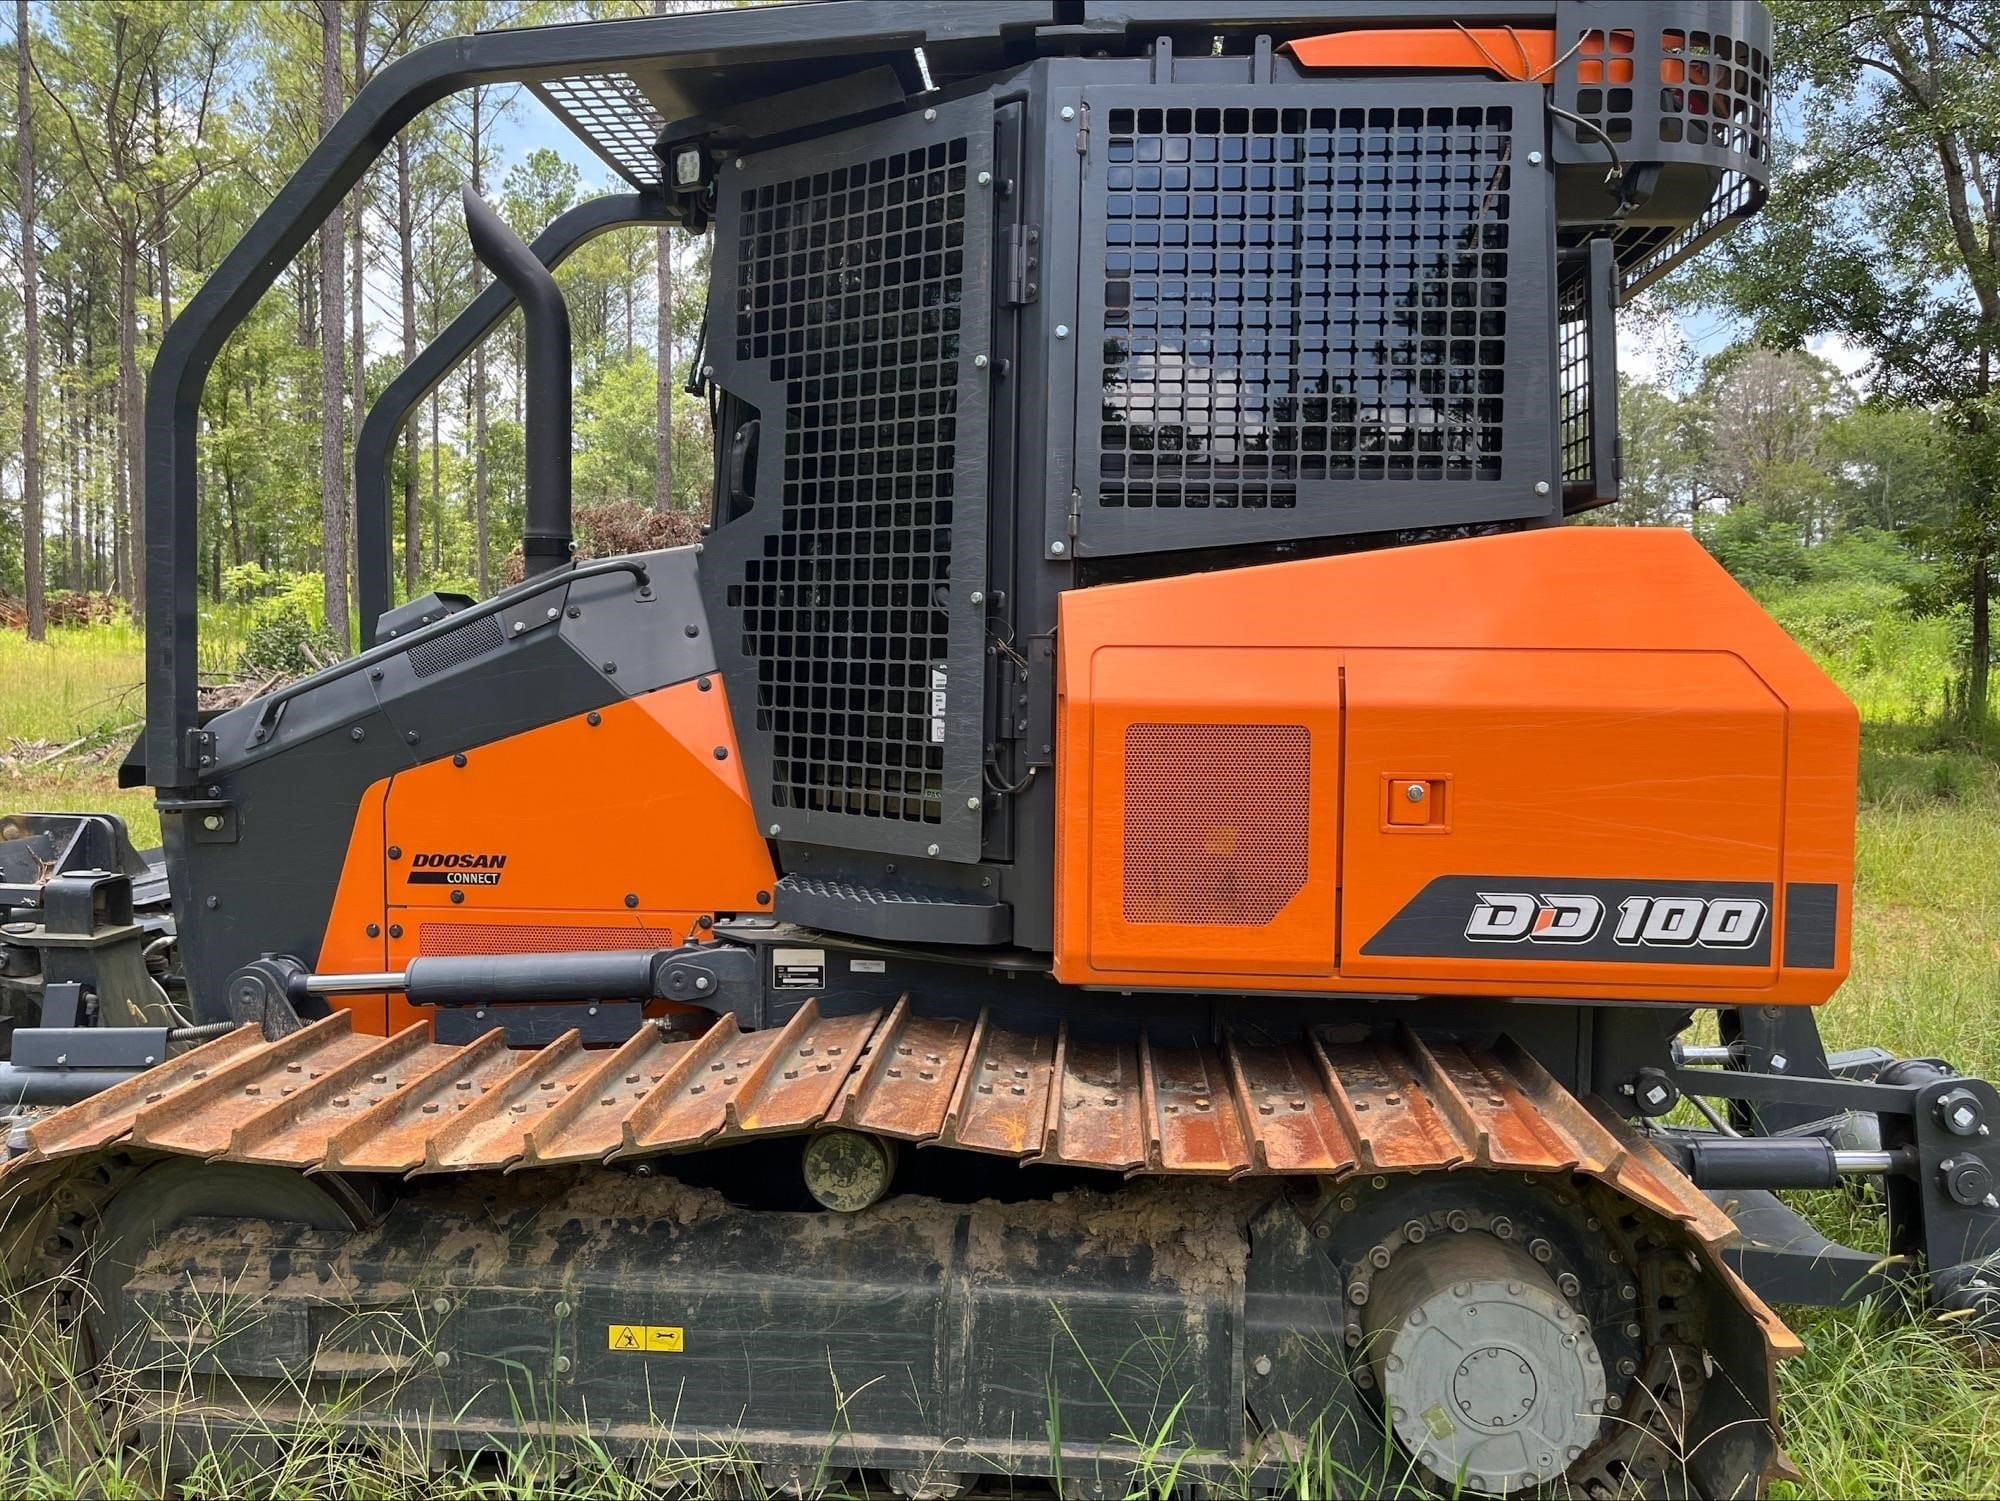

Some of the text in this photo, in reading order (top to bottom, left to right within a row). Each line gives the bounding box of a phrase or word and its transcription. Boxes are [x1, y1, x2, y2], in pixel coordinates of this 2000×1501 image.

[413, 854, 507, 868] DOOSAN
[447, 872, 498, 884] CONNECT
[1463, 892, 1768, 949] DD 100
